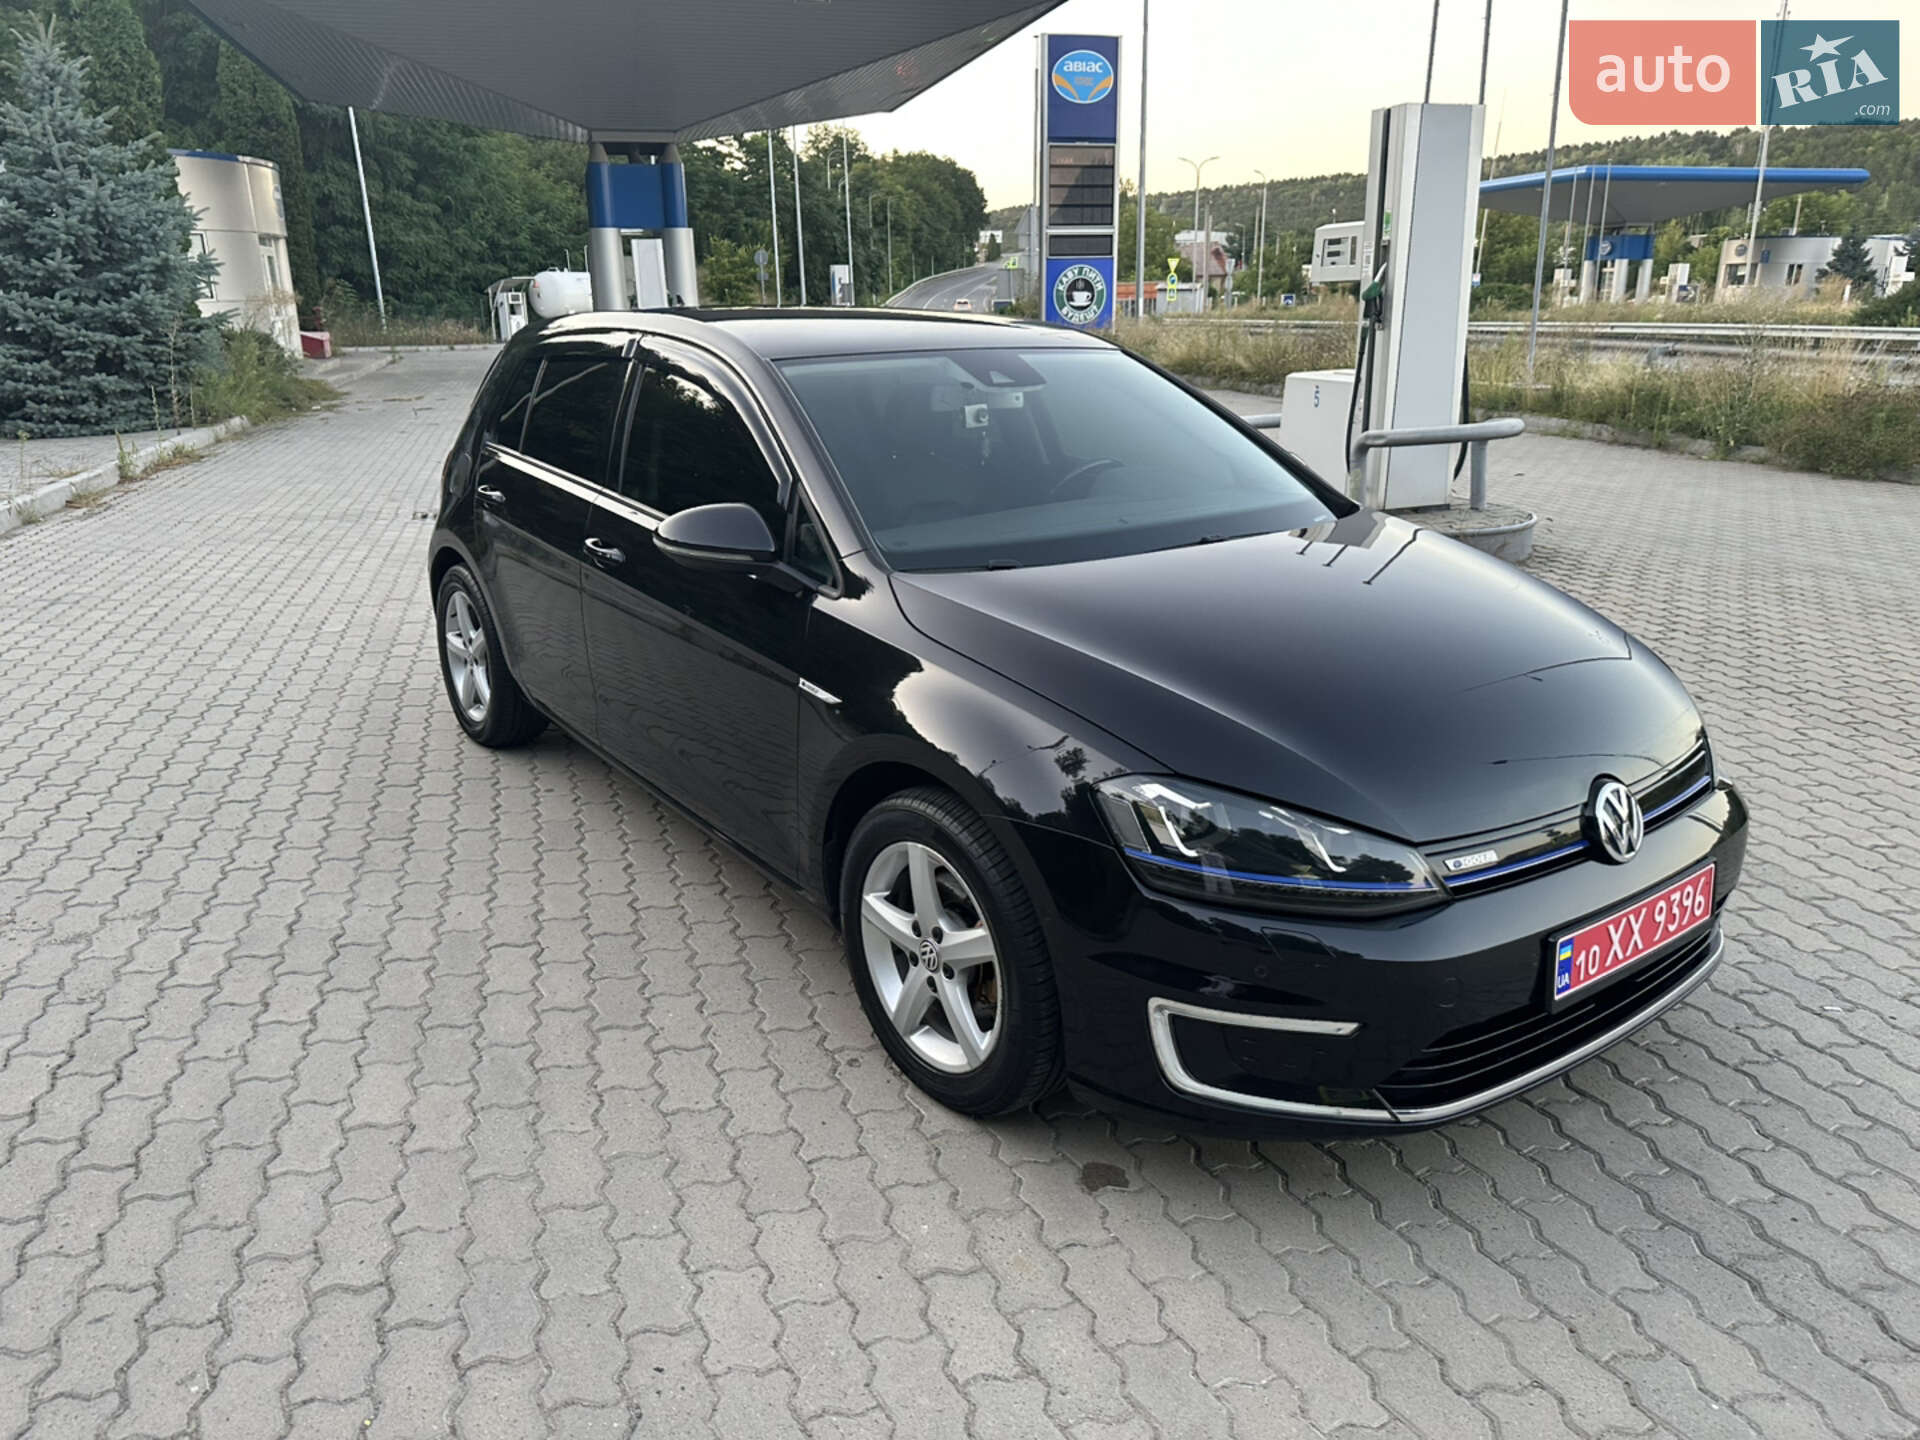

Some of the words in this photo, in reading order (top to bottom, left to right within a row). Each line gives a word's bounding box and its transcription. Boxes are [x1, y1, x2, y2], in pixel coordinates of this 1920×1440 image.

[1576, 945, 1600, 981] 10
[1605, 907, 1647, 967] XX
[1653, 877, 1706, 941] 9396
[1558, 972, 1570, 988] UA
